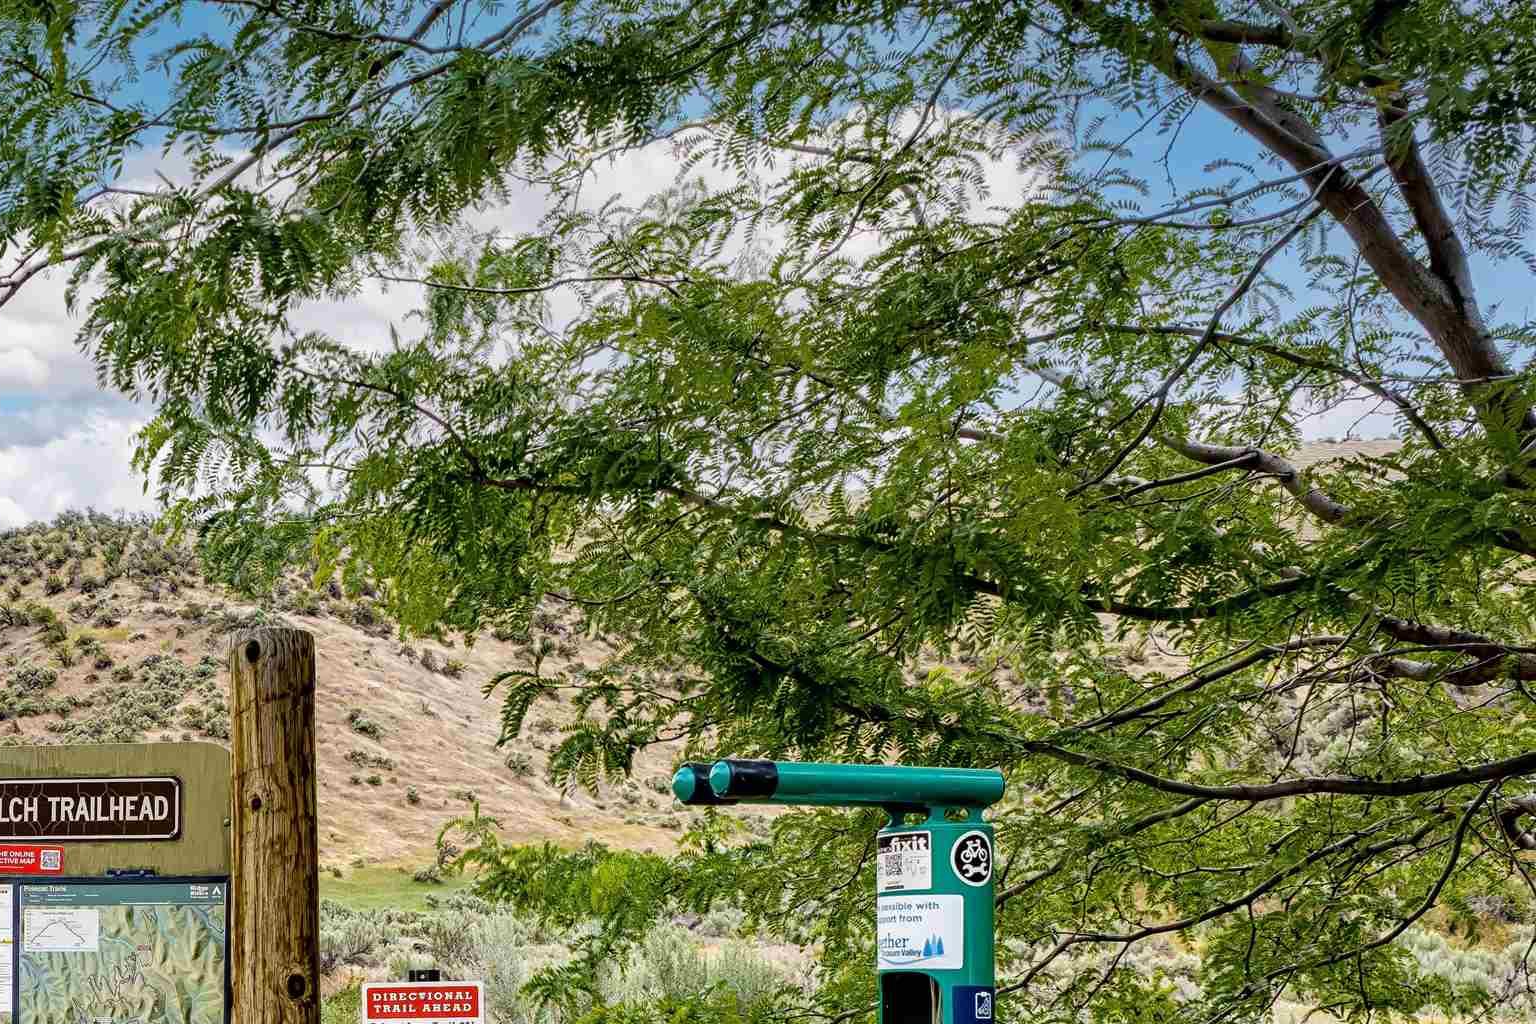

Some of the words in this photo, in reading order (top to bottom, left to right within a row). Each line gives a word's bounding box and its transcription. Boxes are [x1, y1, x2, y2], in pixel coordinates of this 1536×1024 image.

[48, 795, 169, 822] TRAILHEAD
[889, 835, 928, 852] fixit
[915, 901, 940, 910] with
[898, 914, 923, 923] from
[373, 1004, 417, 1013] TRAIL
[422, 1003, 472, 1012] AHEAD
